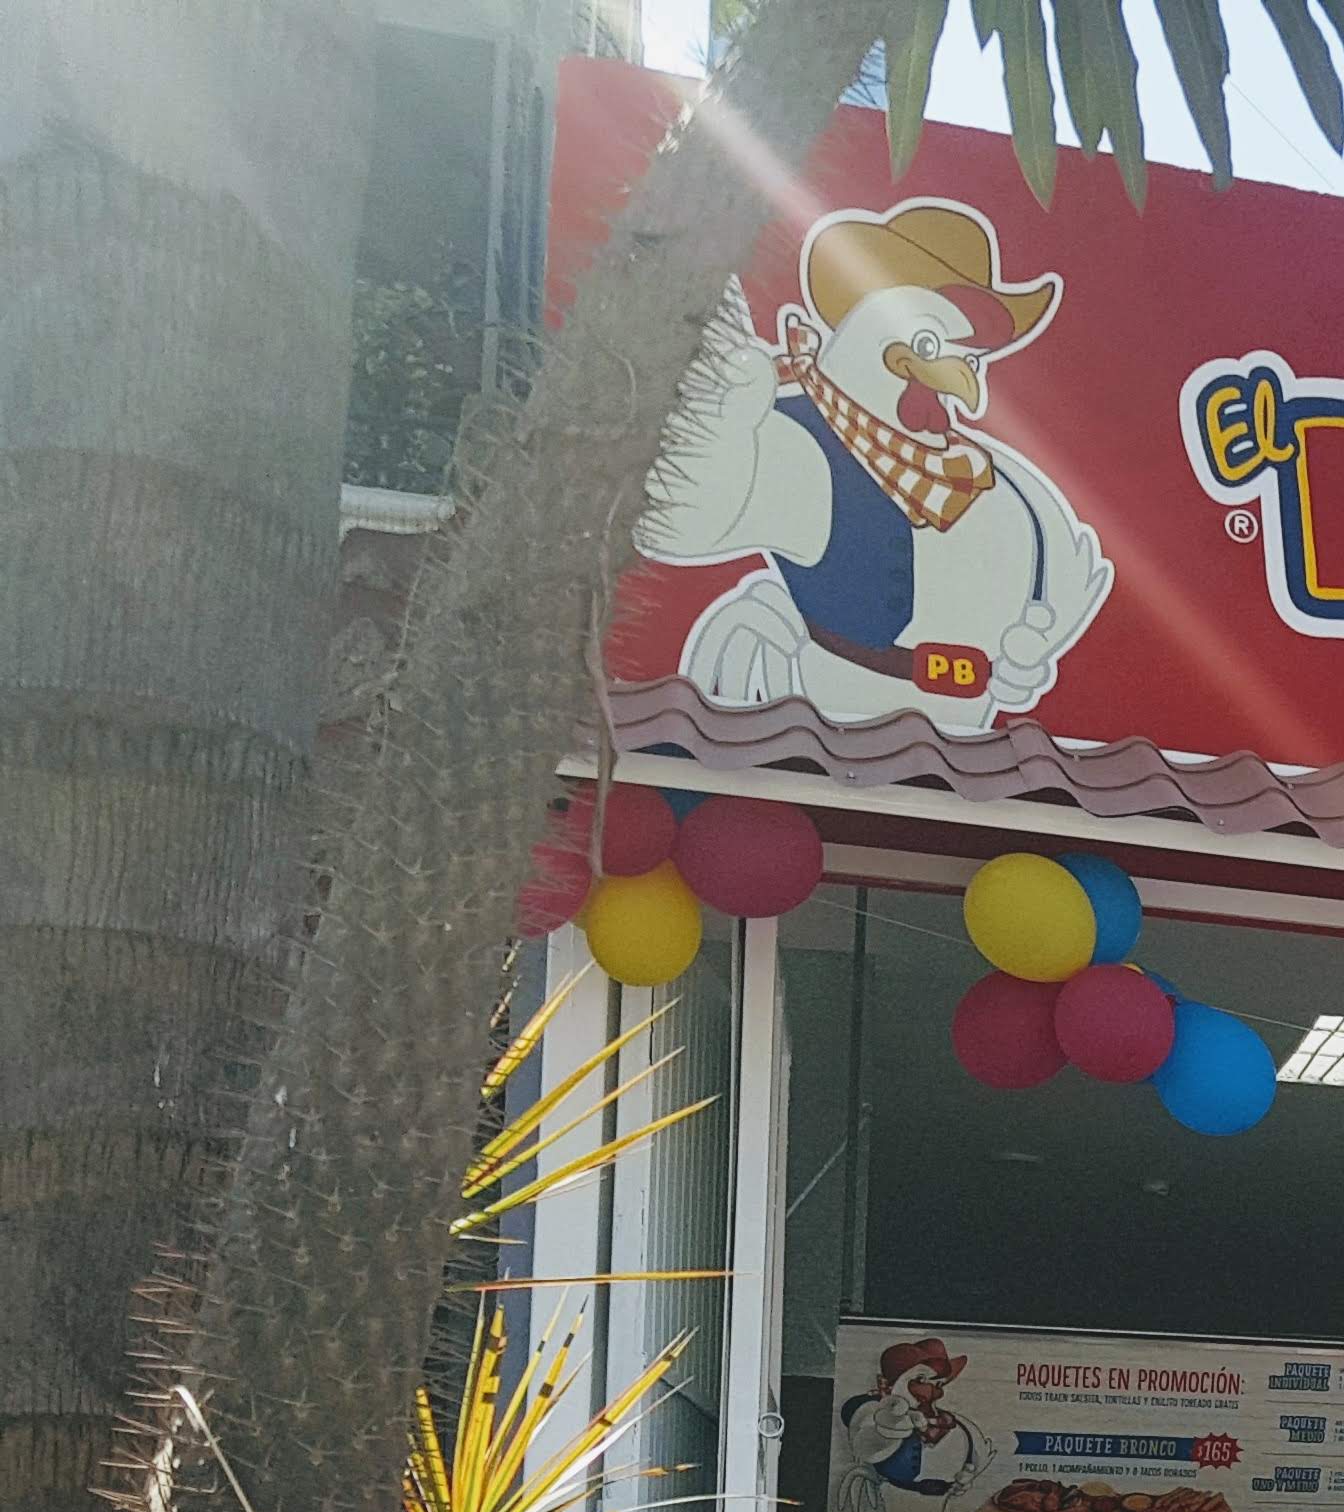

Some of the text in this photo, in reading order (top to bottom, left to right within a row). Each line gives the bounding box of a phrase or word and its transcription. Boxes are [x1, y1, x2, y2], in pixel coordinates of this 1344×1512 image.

[1205, 378, 1296, 482] El
[1285, 1363, 1331, 1378] PAQUETE
[1016, 1363, 1246, 1396] PAQUETES EN PROMOCIÓN:
[1269, 1376, 1330, 1391] INDIVIDUAL
[1280, 1416, 1326, 1431] PAQUETE
[1289, 1429, 1325, 1443] MEDIO
[1044, 1435, 1177, 1457] PAQUETE BRONCO
[1196, 1440, 1232, 1462] $165
[1274, 1466, 1321, 1481] PAQUETE
